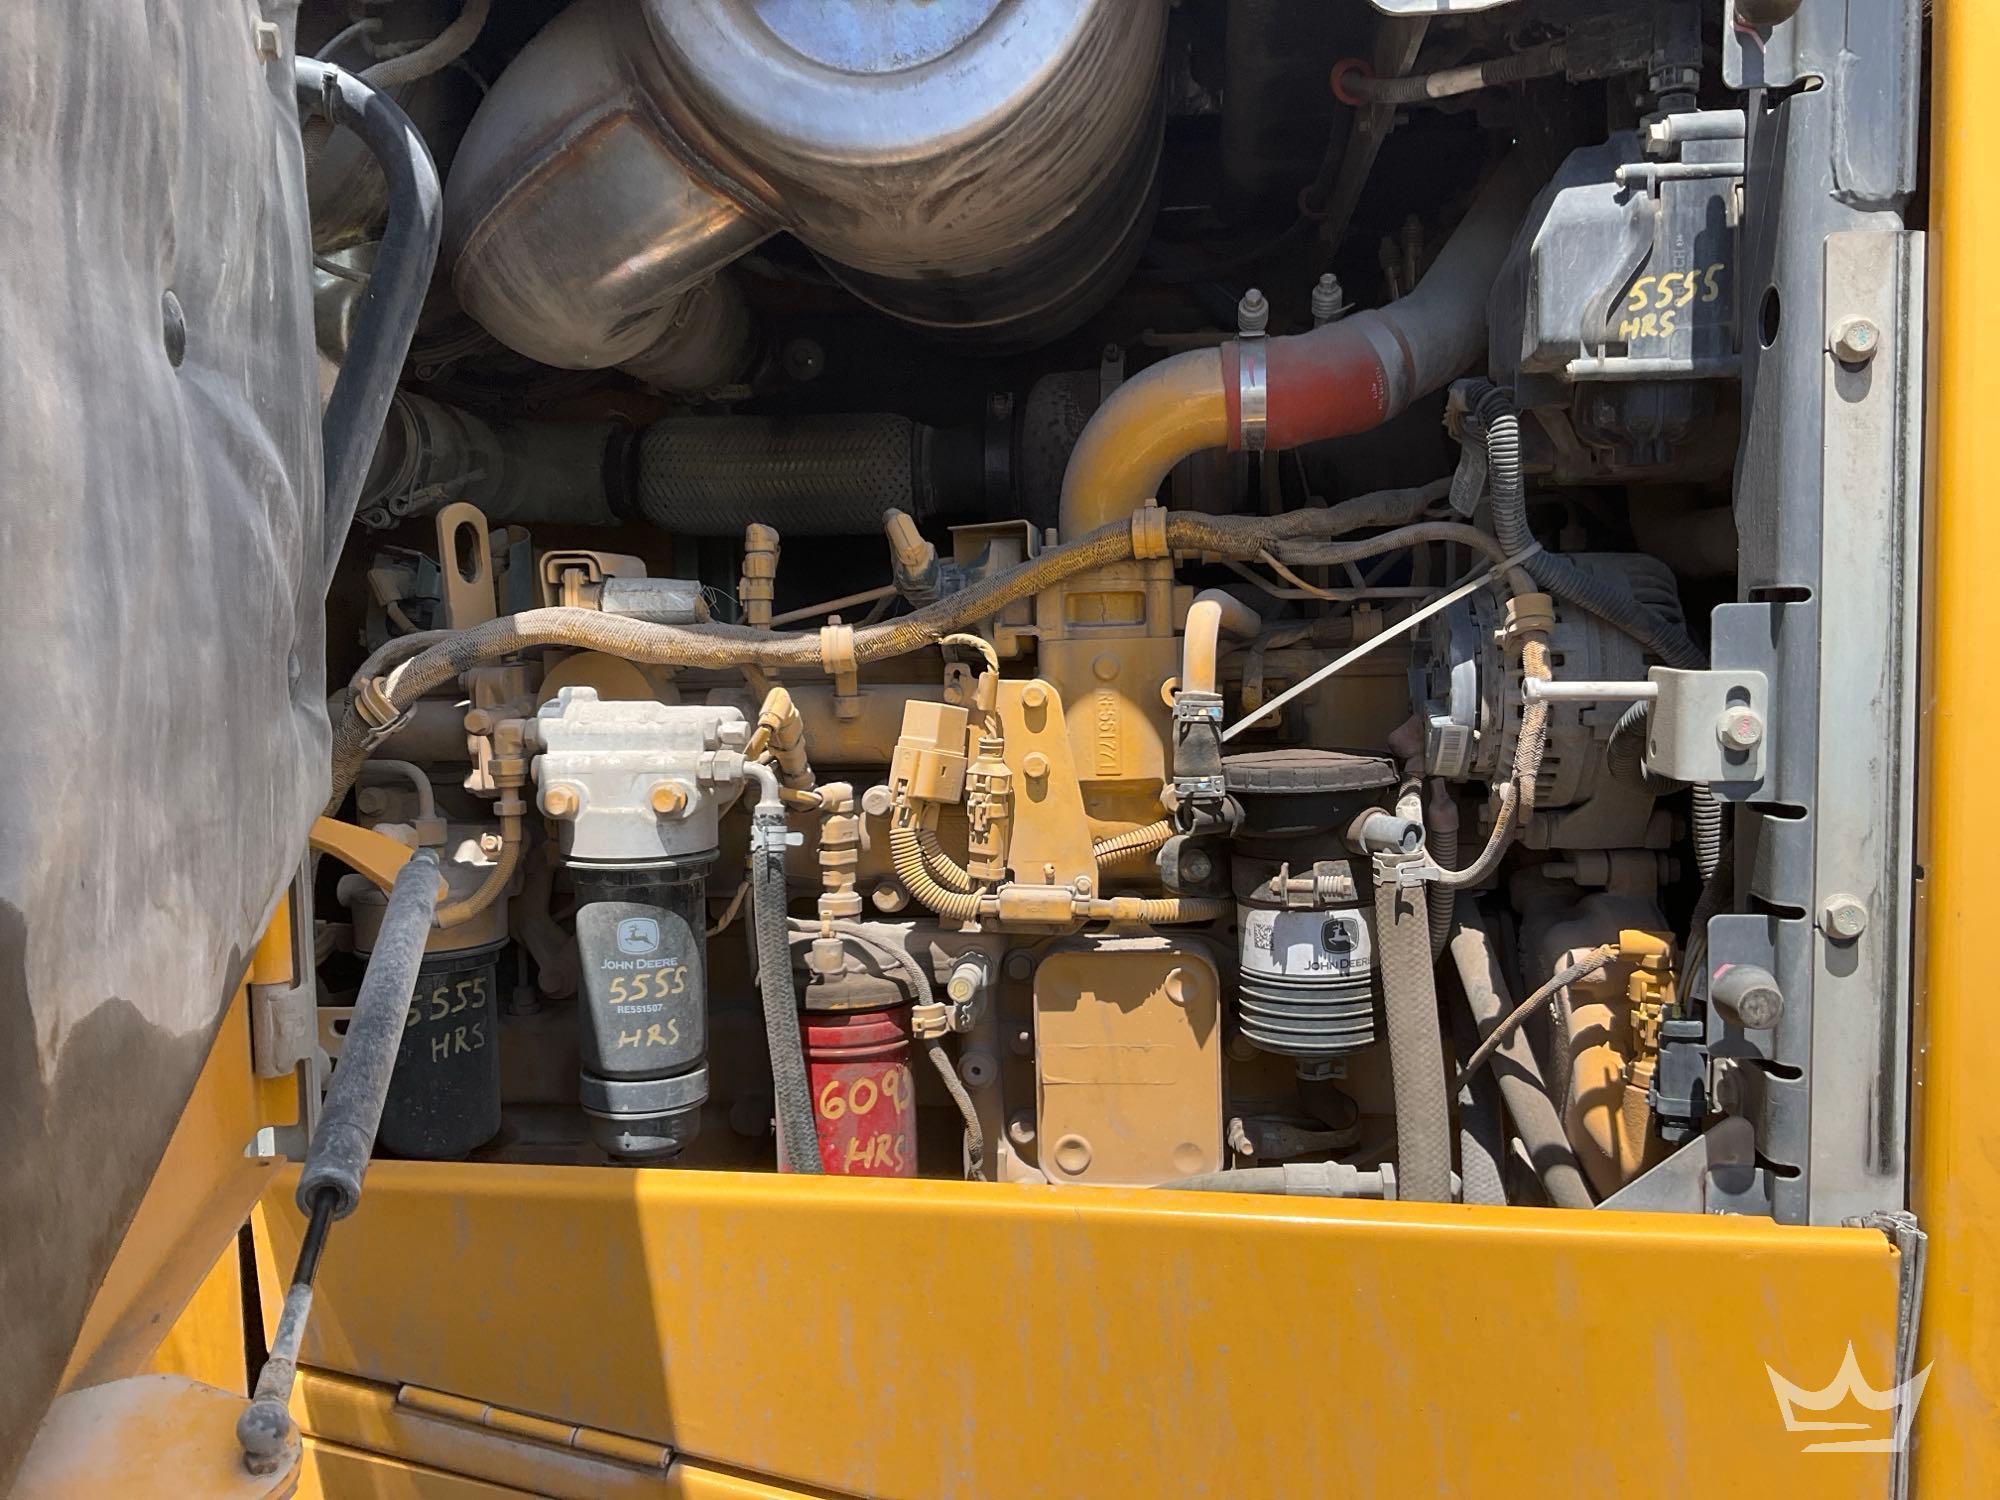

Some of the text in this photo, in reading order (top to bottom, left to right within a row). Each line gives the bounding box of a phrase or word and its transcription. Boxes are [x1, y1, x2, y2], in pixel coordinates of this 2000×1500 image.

[1628, 263, 1725, 311] 5555
[1619, 310, 1676, 340] HRS
[601, 957, 678, 970] JOHN DEERE
[1304, 957, 1370, 971] JOHN DEER
[608, 966, 688, 1004] 5555
[617, 1003, 663, 1014] RE551507
[431, 1021, 486, 1063] HRS
[617, 1018, 680, 1048] HRS
[844, 1133, 905, 1174] HRS
